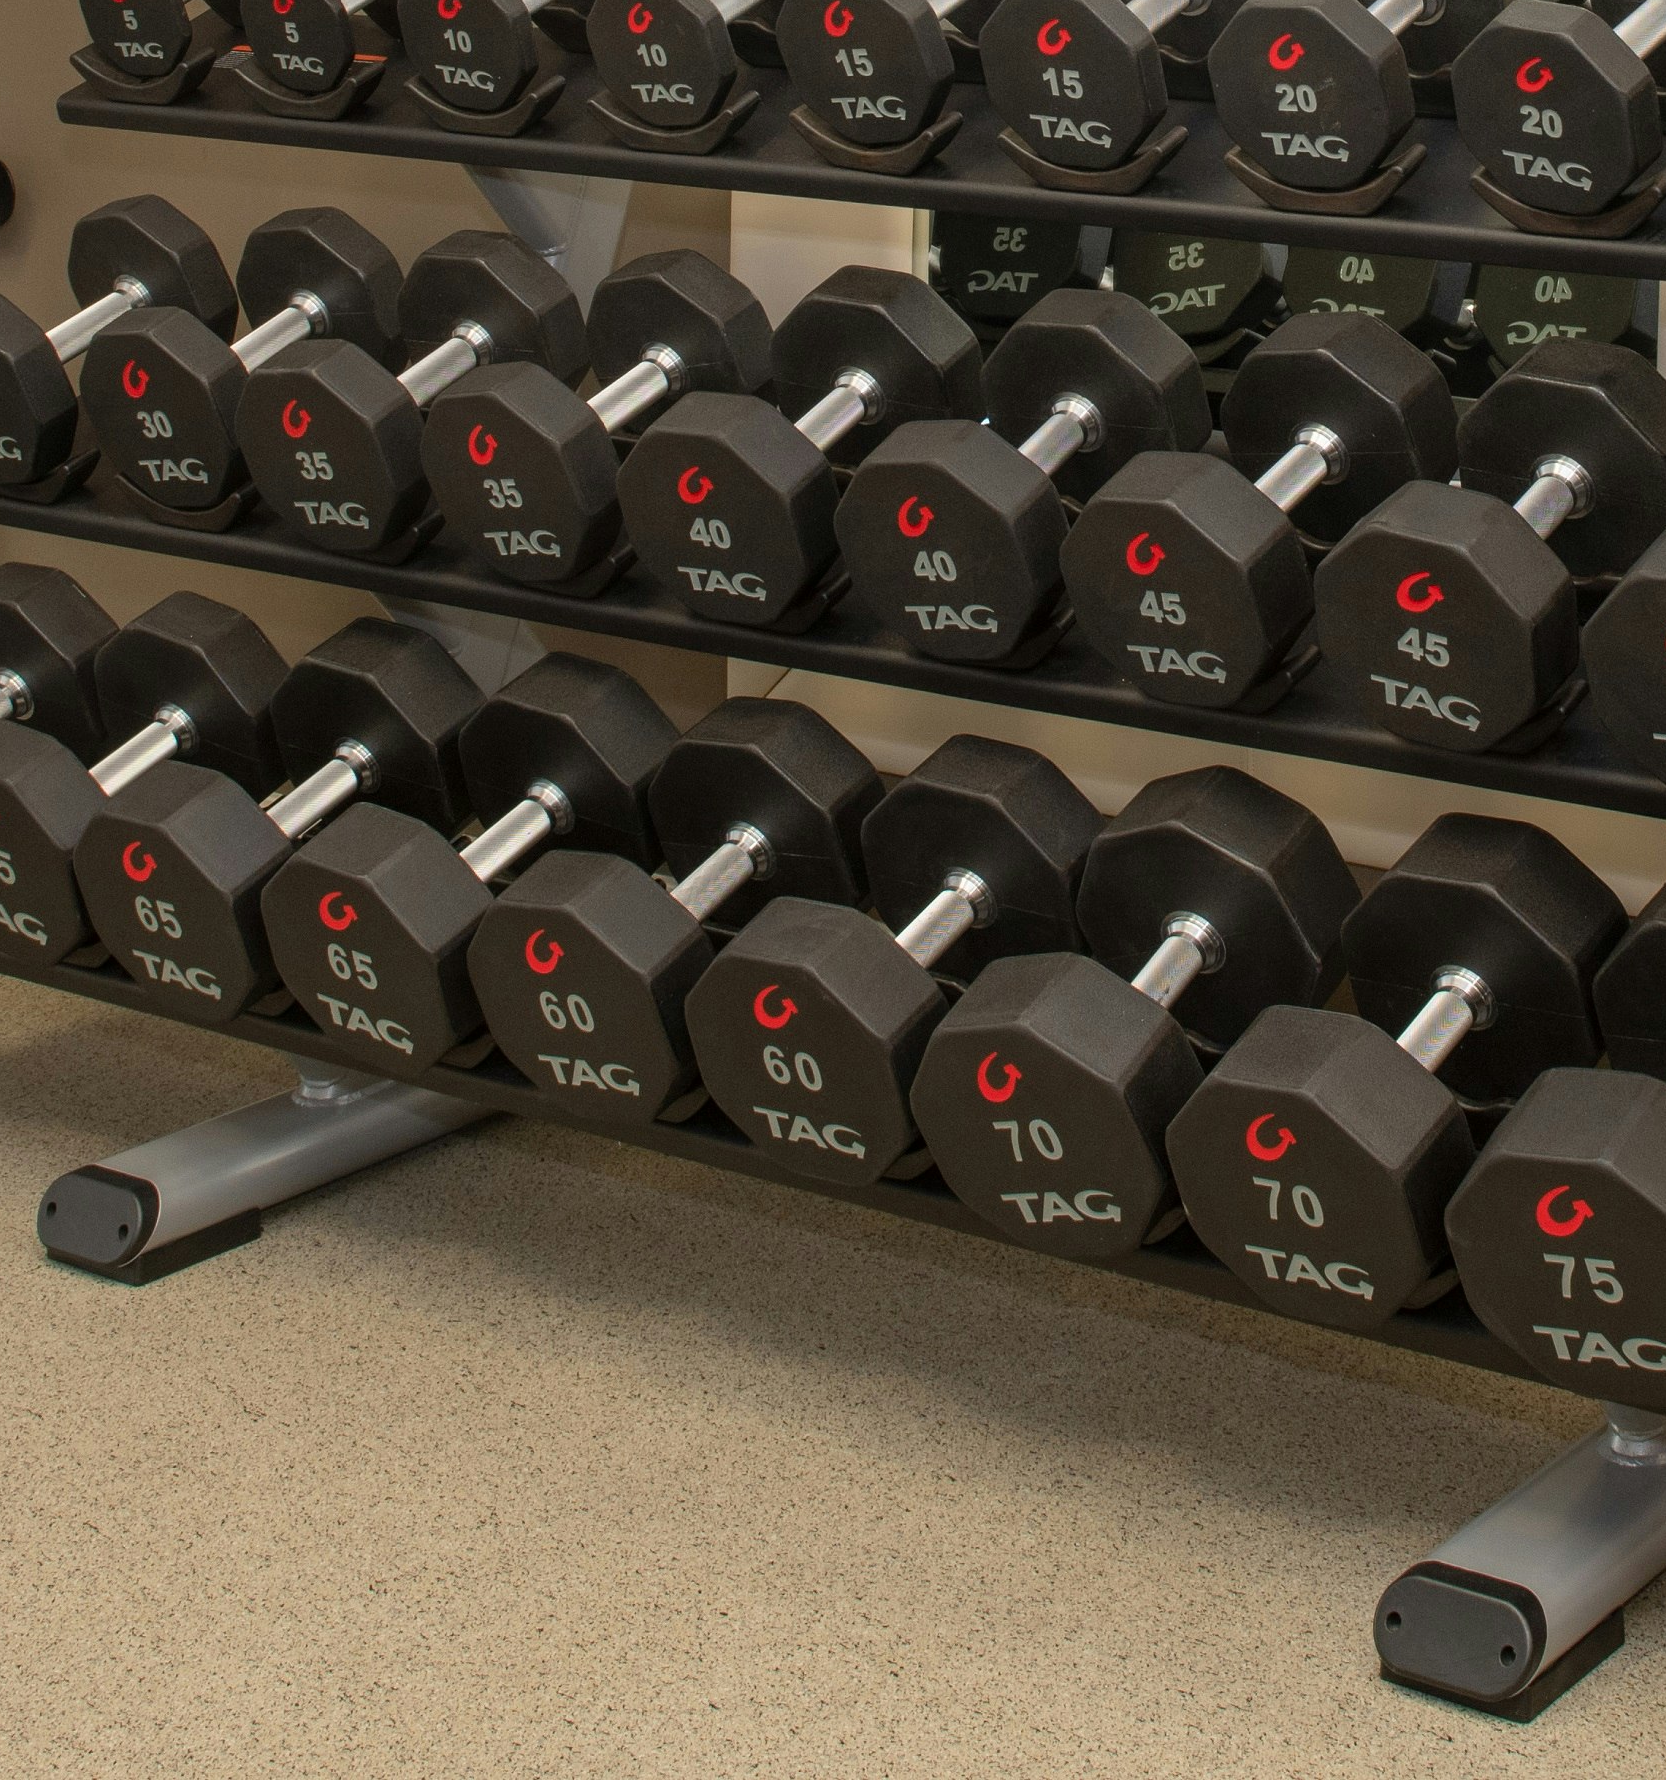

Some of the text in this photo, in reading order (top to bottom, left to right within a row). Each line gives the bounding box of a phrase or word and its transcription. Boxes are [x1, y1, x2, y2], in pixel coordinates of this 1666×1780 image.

[123, 10, 137, 29] 5
[285, 22, 299, 43] 5
[114, 43, 163, 59] TAG
[637, 44, 667, 66] 10
[835, 49, 873, 76] 15
[631, 84, 694, 104] TAG
[1276, 84, 1317, 112] 20
[1520, 105, 1562, 138] 20
[1261, 133, 1349, 162] TAG
[137, 411, 172, 438] 30
[296, 452, 333, 480] 35
[484, 479, 522, 508] 35
[294, 502, 369, 529] TAG
[914, 551, 956, 581] 40
[905, 605, 997, 632] TAG
[1140, 591, 1186, 625] 45
[328, 944, 377, 989] 65
[540, 992, 594, 1032] 60
[538, 1055, 639, 1096] TAG
[1253, 1177, 1324, 1227] 70
[1245, 1245, 1374, 1300] TAG
